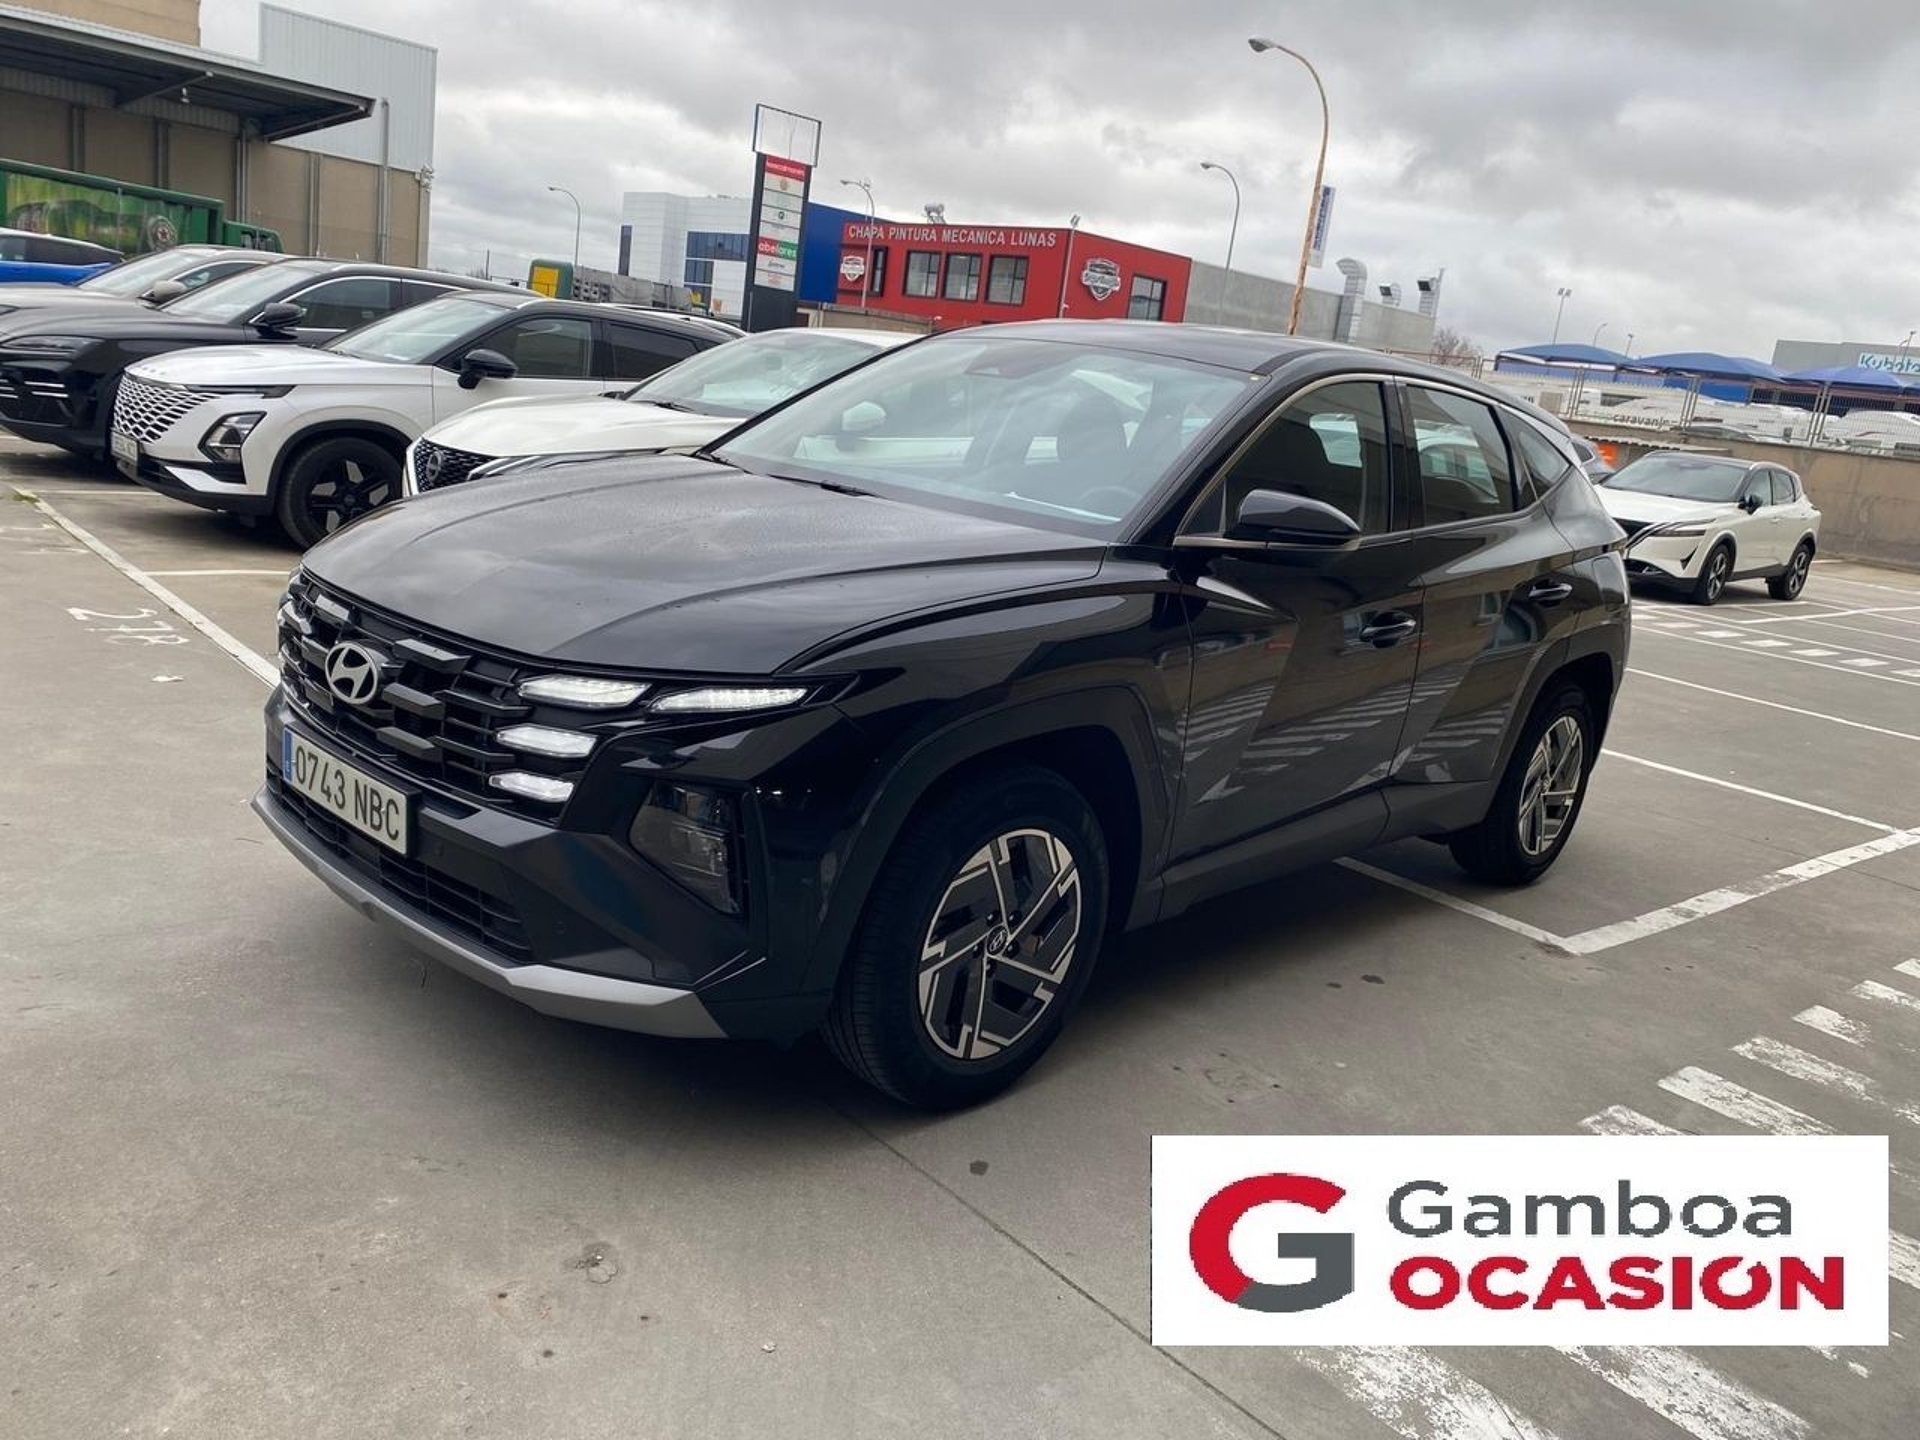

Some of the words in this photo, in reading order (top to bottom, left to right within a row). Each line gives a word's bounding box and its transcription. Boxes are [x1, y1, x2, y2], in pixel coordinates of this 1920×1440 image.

[848, 225, 885, 239] CHAPA
[888, 226, 937, 241] PINTURA
[942, 228, 1006, 246] MECANICA
[1010, 230, 1057, 247] LUNAS
[1860, 354, 1920, 373] Kubota
[295, 745, 346, 810] 0743
[354, 779, 400, 841] NBC
